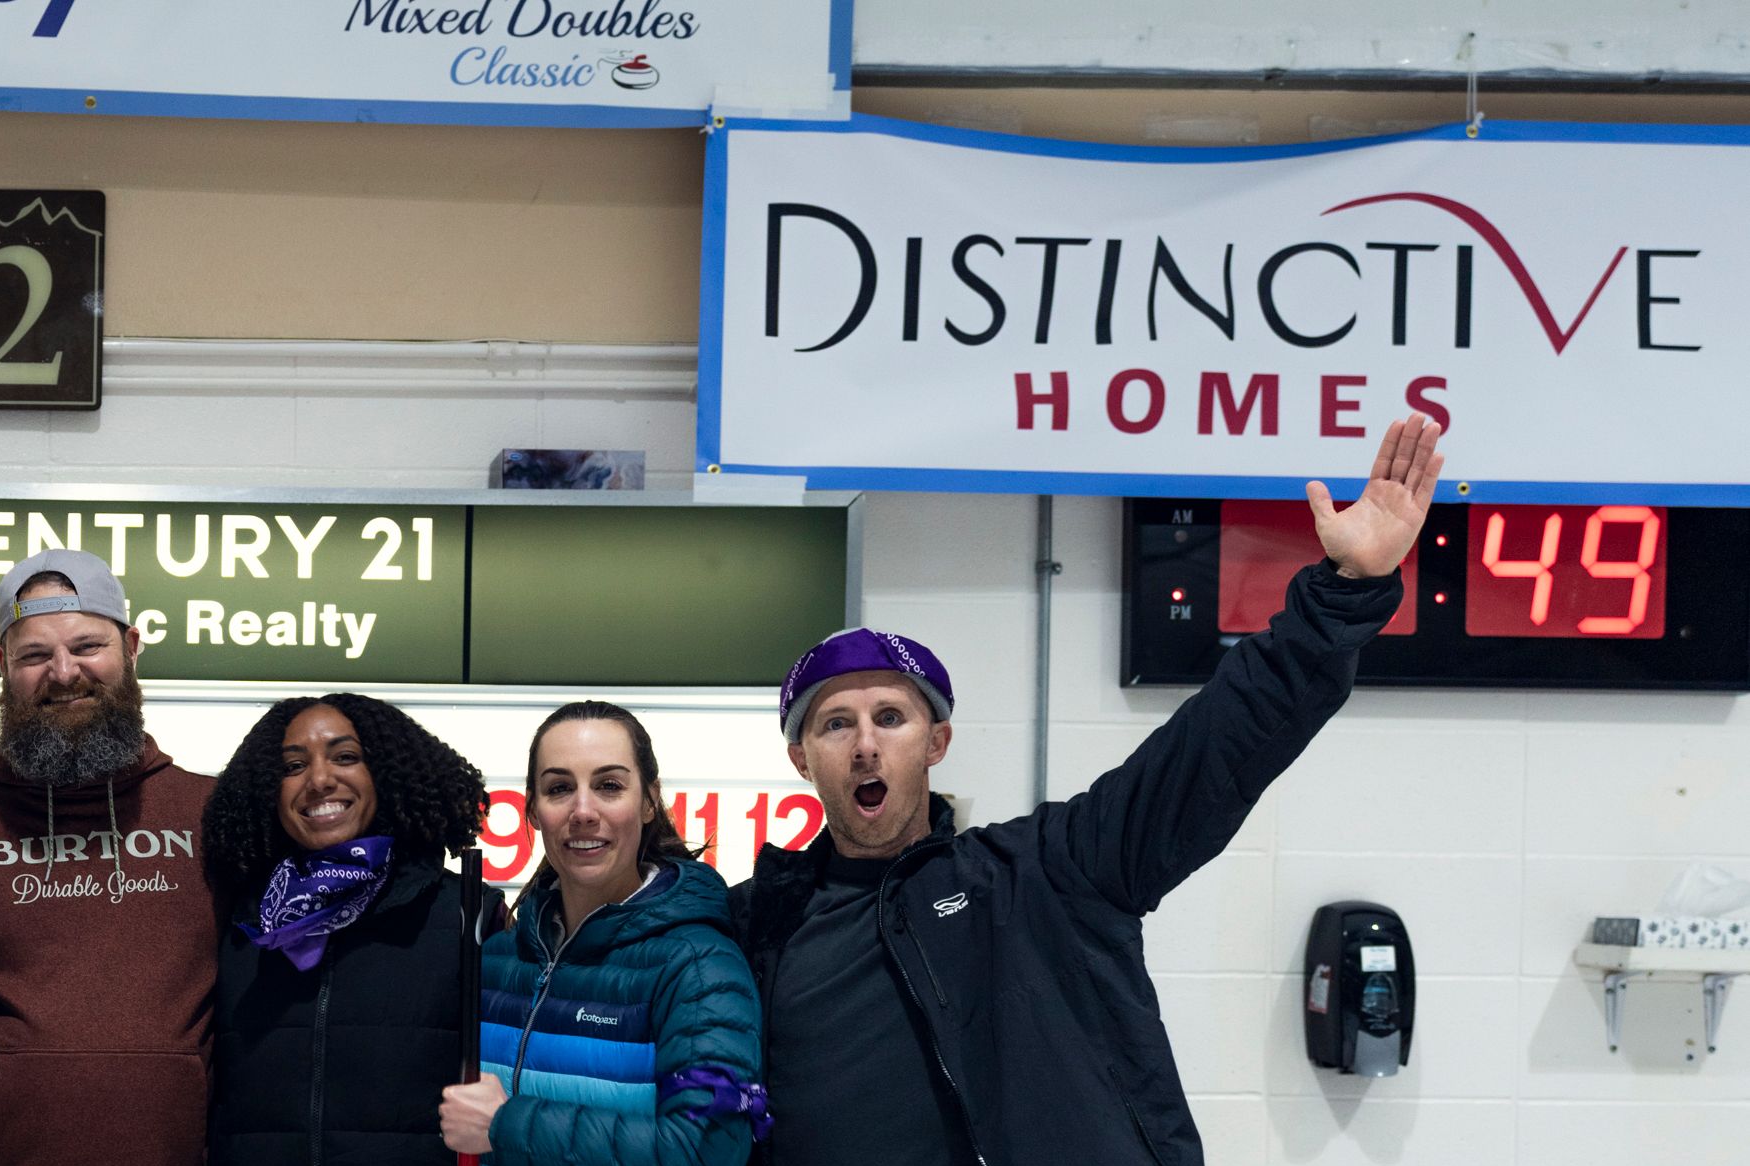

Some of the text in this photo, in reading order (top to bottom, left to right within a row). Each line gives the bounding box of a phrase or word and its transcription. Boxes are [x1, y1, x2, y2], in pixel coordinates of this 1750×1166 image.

[344, 0, 700, 39] Mixed Doubles
[450, 46, 595, 87] Classic
[764, 191, 1702, 355] DISTINCTIVE
[1013, 368, 1450, 437] HOMES
[1172, 510, 1193, 524] AM
[361, 516, 433, 581] 21
[1482, 506, 1659, 634] 49
[187, 602, 377, 658] Realty
[1170, 605, 1192, 620] PM
[12, 870, 179, 904] Durable Goods
